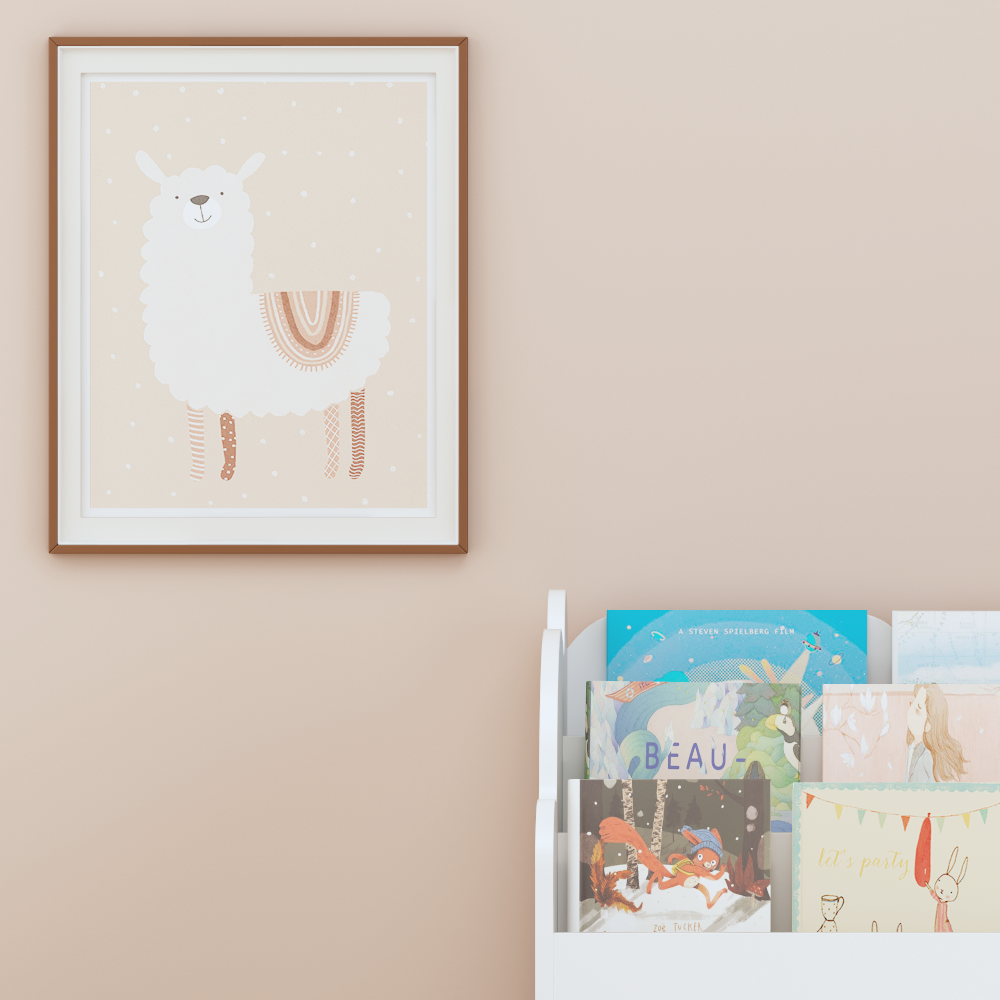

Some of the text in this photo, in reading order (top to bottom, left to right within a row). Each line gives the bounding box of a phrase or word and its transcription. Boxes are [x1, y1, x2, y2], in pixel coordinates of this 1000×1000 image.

[818, 848, 910, 880] let's party
[673, 922, 704, 932] TUCKER
